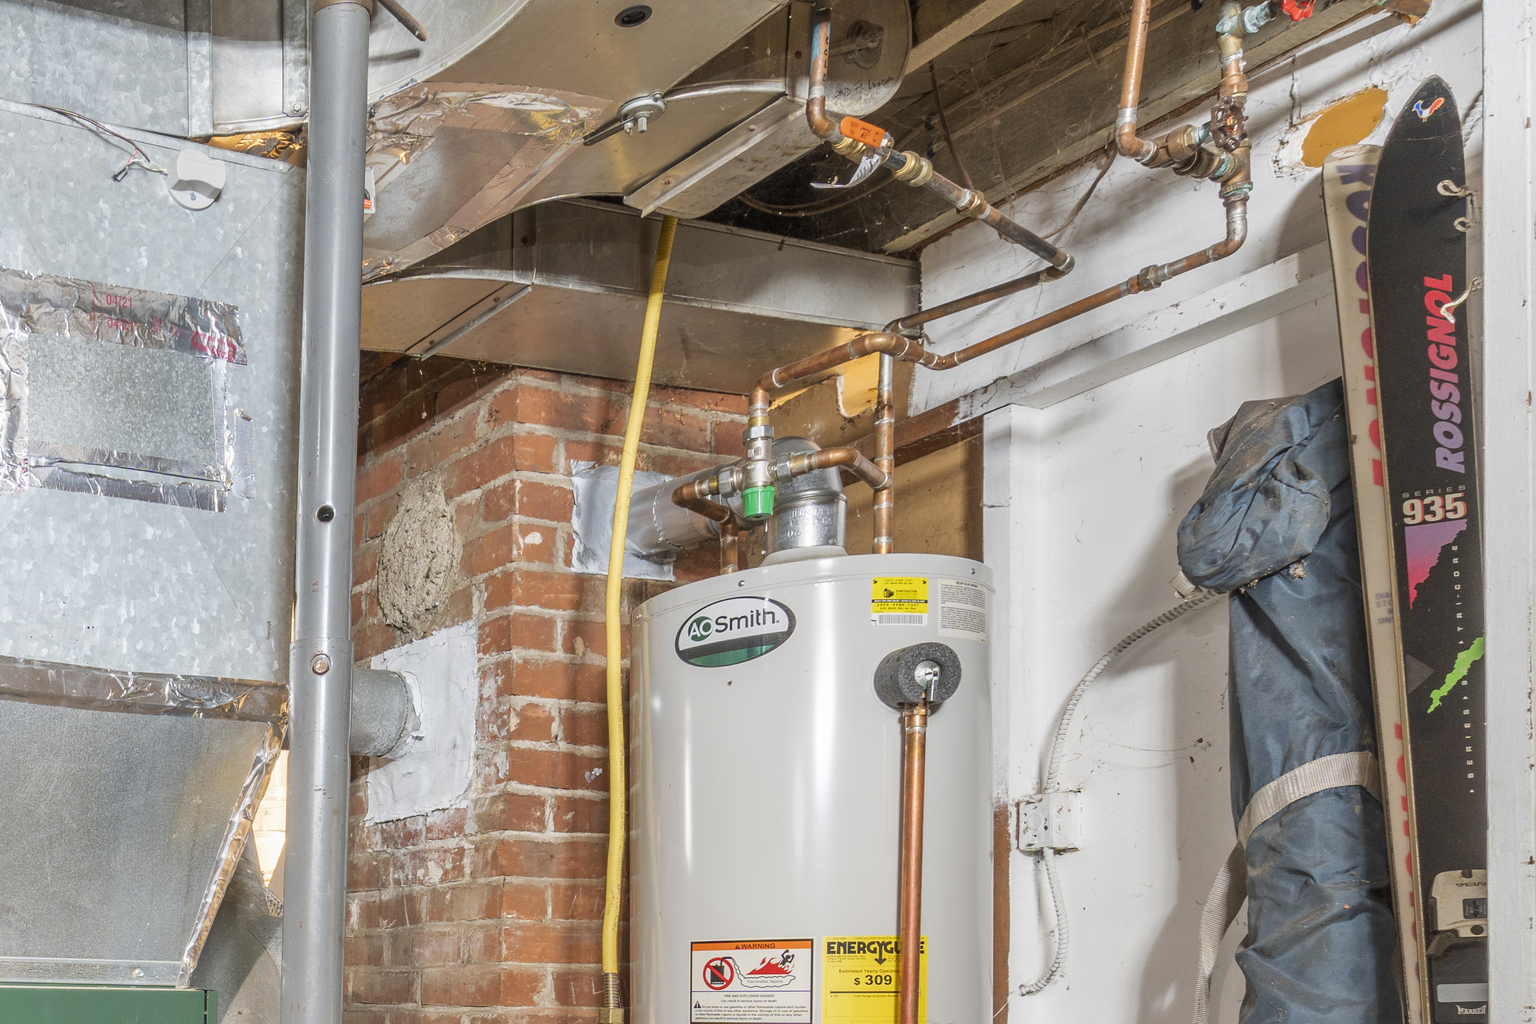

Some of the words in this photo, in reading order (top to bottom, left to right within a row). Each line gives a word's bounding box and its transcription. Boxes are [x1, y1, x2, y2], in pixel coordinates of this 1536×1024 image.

[106, 293, 133, 309] 04/21
[1423, 273, 1466, 474] ROSSIGNOL
[1402, 485, 1466, 498] SERIES
[1402, 493, 1467, 525] 935
[715, 607, 775, 633] Smith
[827, 941, 924, 955] ENERGYGUE
[854, 977, 861, 986] $
[865, 974, 893, 986] 309
